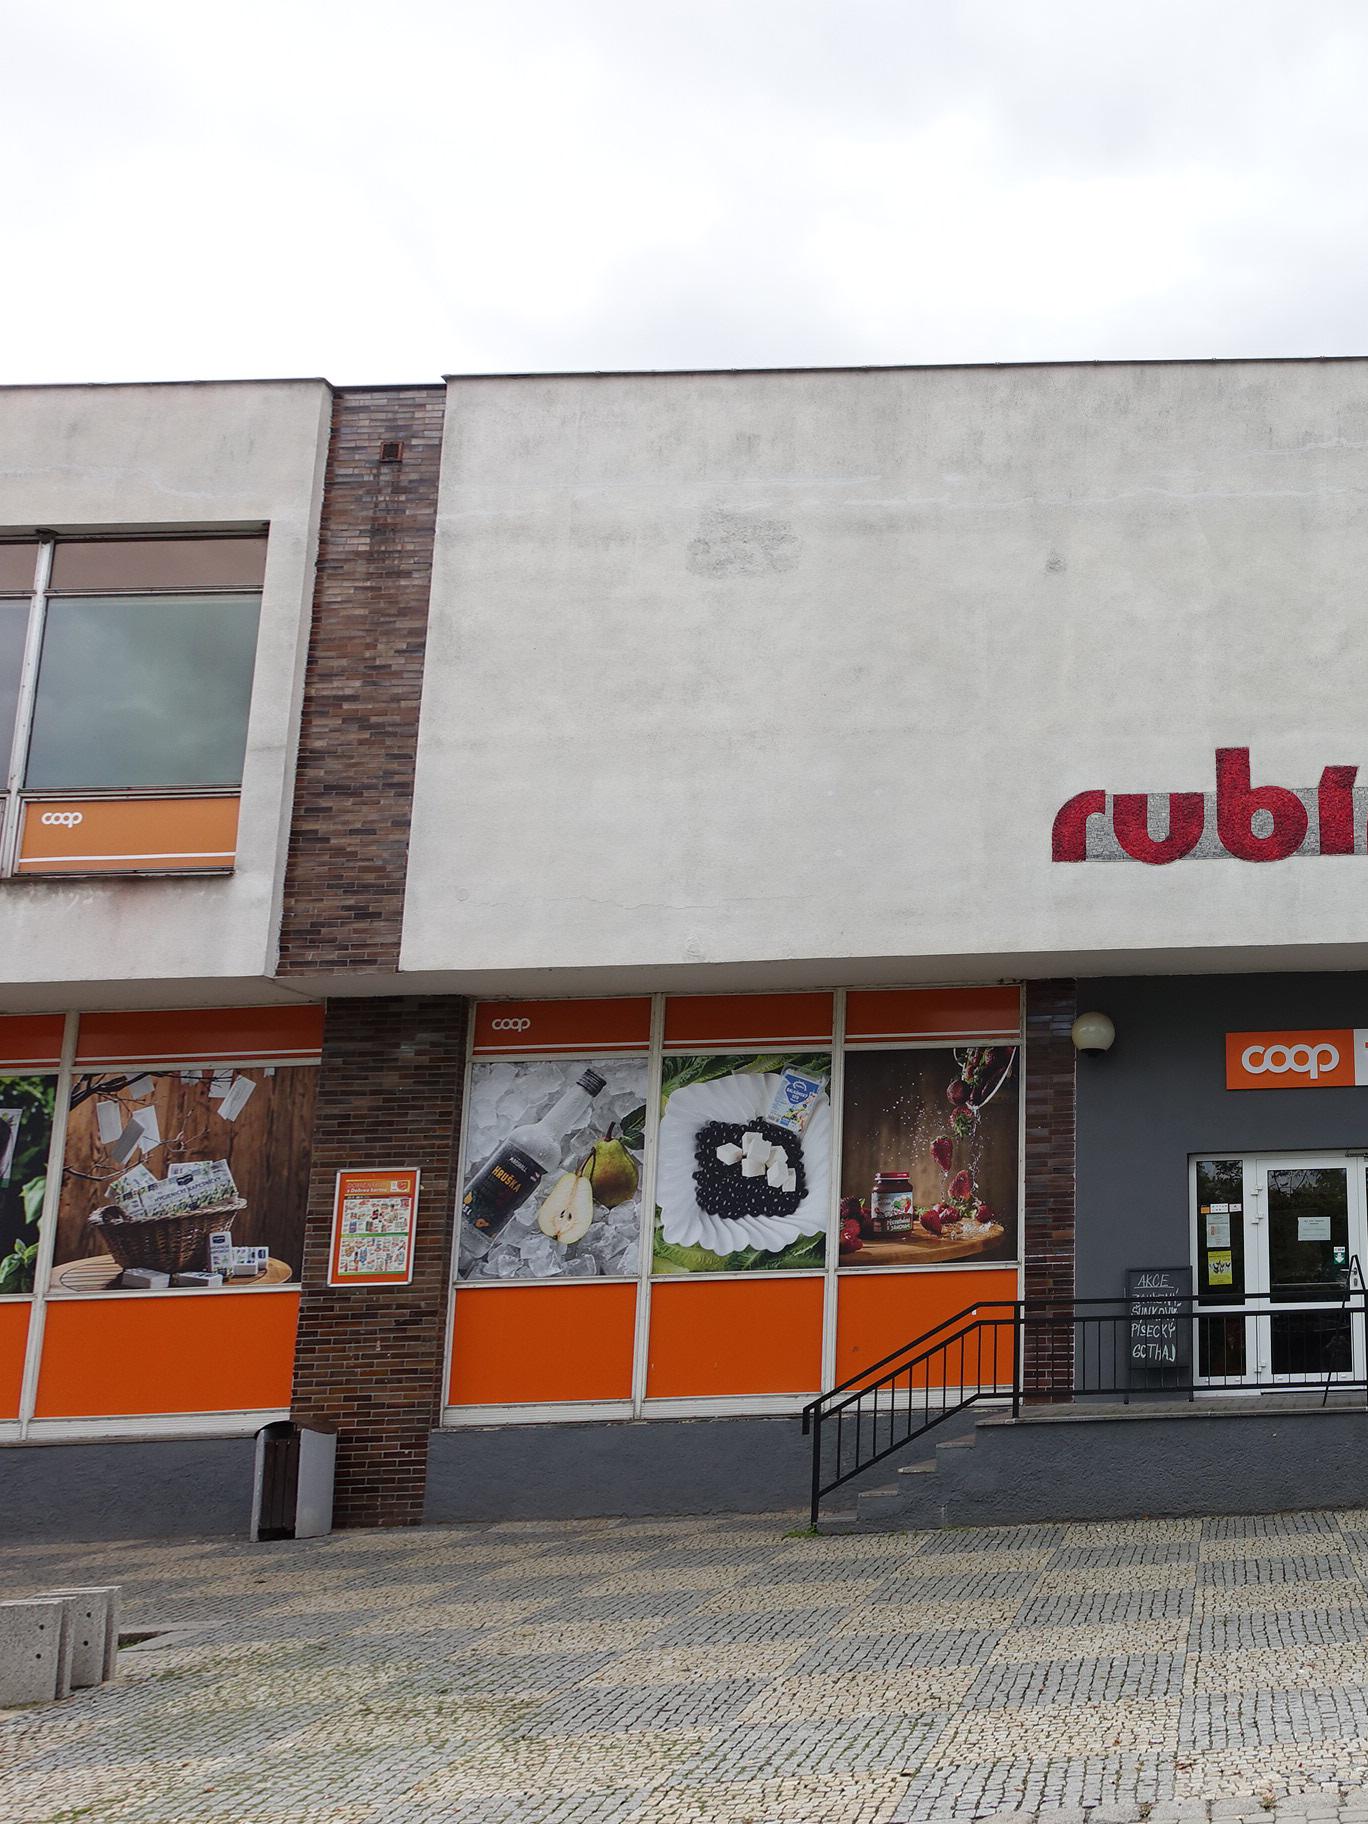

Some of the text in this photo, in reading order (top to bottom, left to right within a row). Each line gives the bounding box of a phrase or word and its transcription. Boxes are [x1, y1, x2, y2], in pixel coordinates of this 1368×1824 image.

[41, 812, 83, 828] coop
[491, 1018, 531, 1032] coop
[1241, 1043, 1340, 1080] coop
[491, 1166, 522, 1193] HRUŠKA
[1137, 1274, 1171, 1288] AKCE
